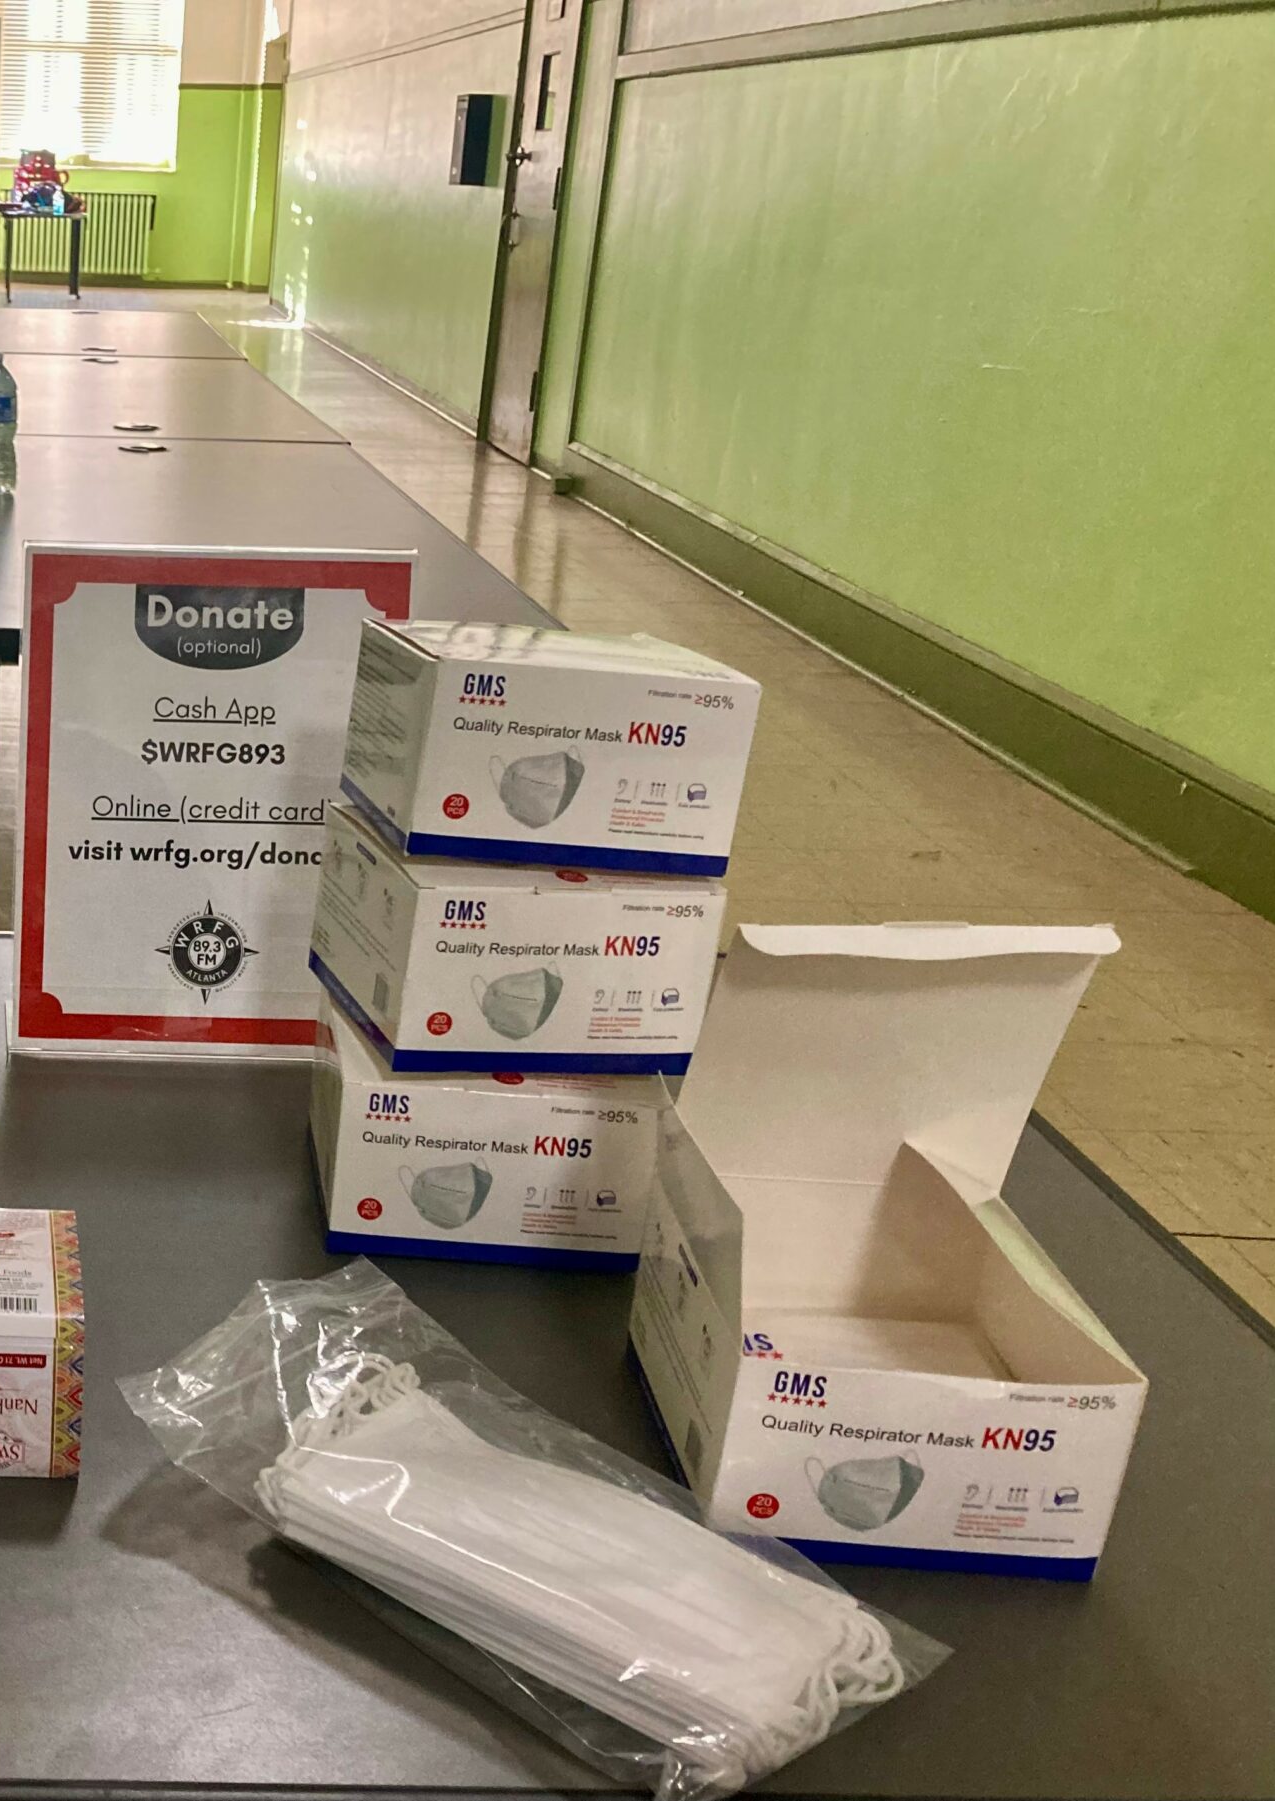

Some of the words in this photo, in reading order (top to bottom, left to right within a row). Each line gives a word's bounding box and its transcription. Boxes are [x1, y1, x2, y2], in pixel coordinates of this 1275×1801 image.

[147, 594, 294, 630] Donate
[177, 637, 262, 658] (optional)
[464, 673, 507, 697] GMS
[154, 697, 217, 720] Cash
[225, 698, 276, 725] App
[694, 694, 734, 710] ≥95%
[453, 716, 504, 735] Quality
[507, 719, 582, 741] Respirator
[585, 727, 623, 743] Mask
[627, 721, 687, 747] KN95
[140, 739, 285, 766] $WRFG893
[92, 795, 171, 819] Online
[180, 796, 259, 824] (credit
[269, 798, 331, 822] card
[450, 796, 464, 807] 20
[69, 840, 123, 861] visit
[444, 900, 487, 922] GMS
[667, 905, 704, 918] ≥95%
[193, 940, 222, 953] 89.3
[435, 940, 486, 956] Quality
[489, 941, 560, 959] Respirator
[563, 943, 600, 957] Mask
[604, 935, 661, 958] KN95
[197, 954, 216, 965] FM
[186, 969, 228, 982] ATLANTA
[433, 1014, 447, 1024] 20
[369, 1093, 410, 1115] GMS
[598, 1110, 638, 1124] ≥95%
[362, 1130, 411, 1148] Quality
[415, 1135, 487, 1153] Respirator
[491, 1140, 529, 1155] Mask
[533, 1135, 592, 1159] KN95
[363, 1200, 378, 1210] 20
[774, 1371, 827, 1398] GMS
[762, 1414, 825, 1437] Quality
[830, 1422, 922, 1445] Respirator
[926, 1432, 975, 1449] Mask
[981, 1427, 1057, 1452] KN95
[755, 1495, 773, 1507] 20
